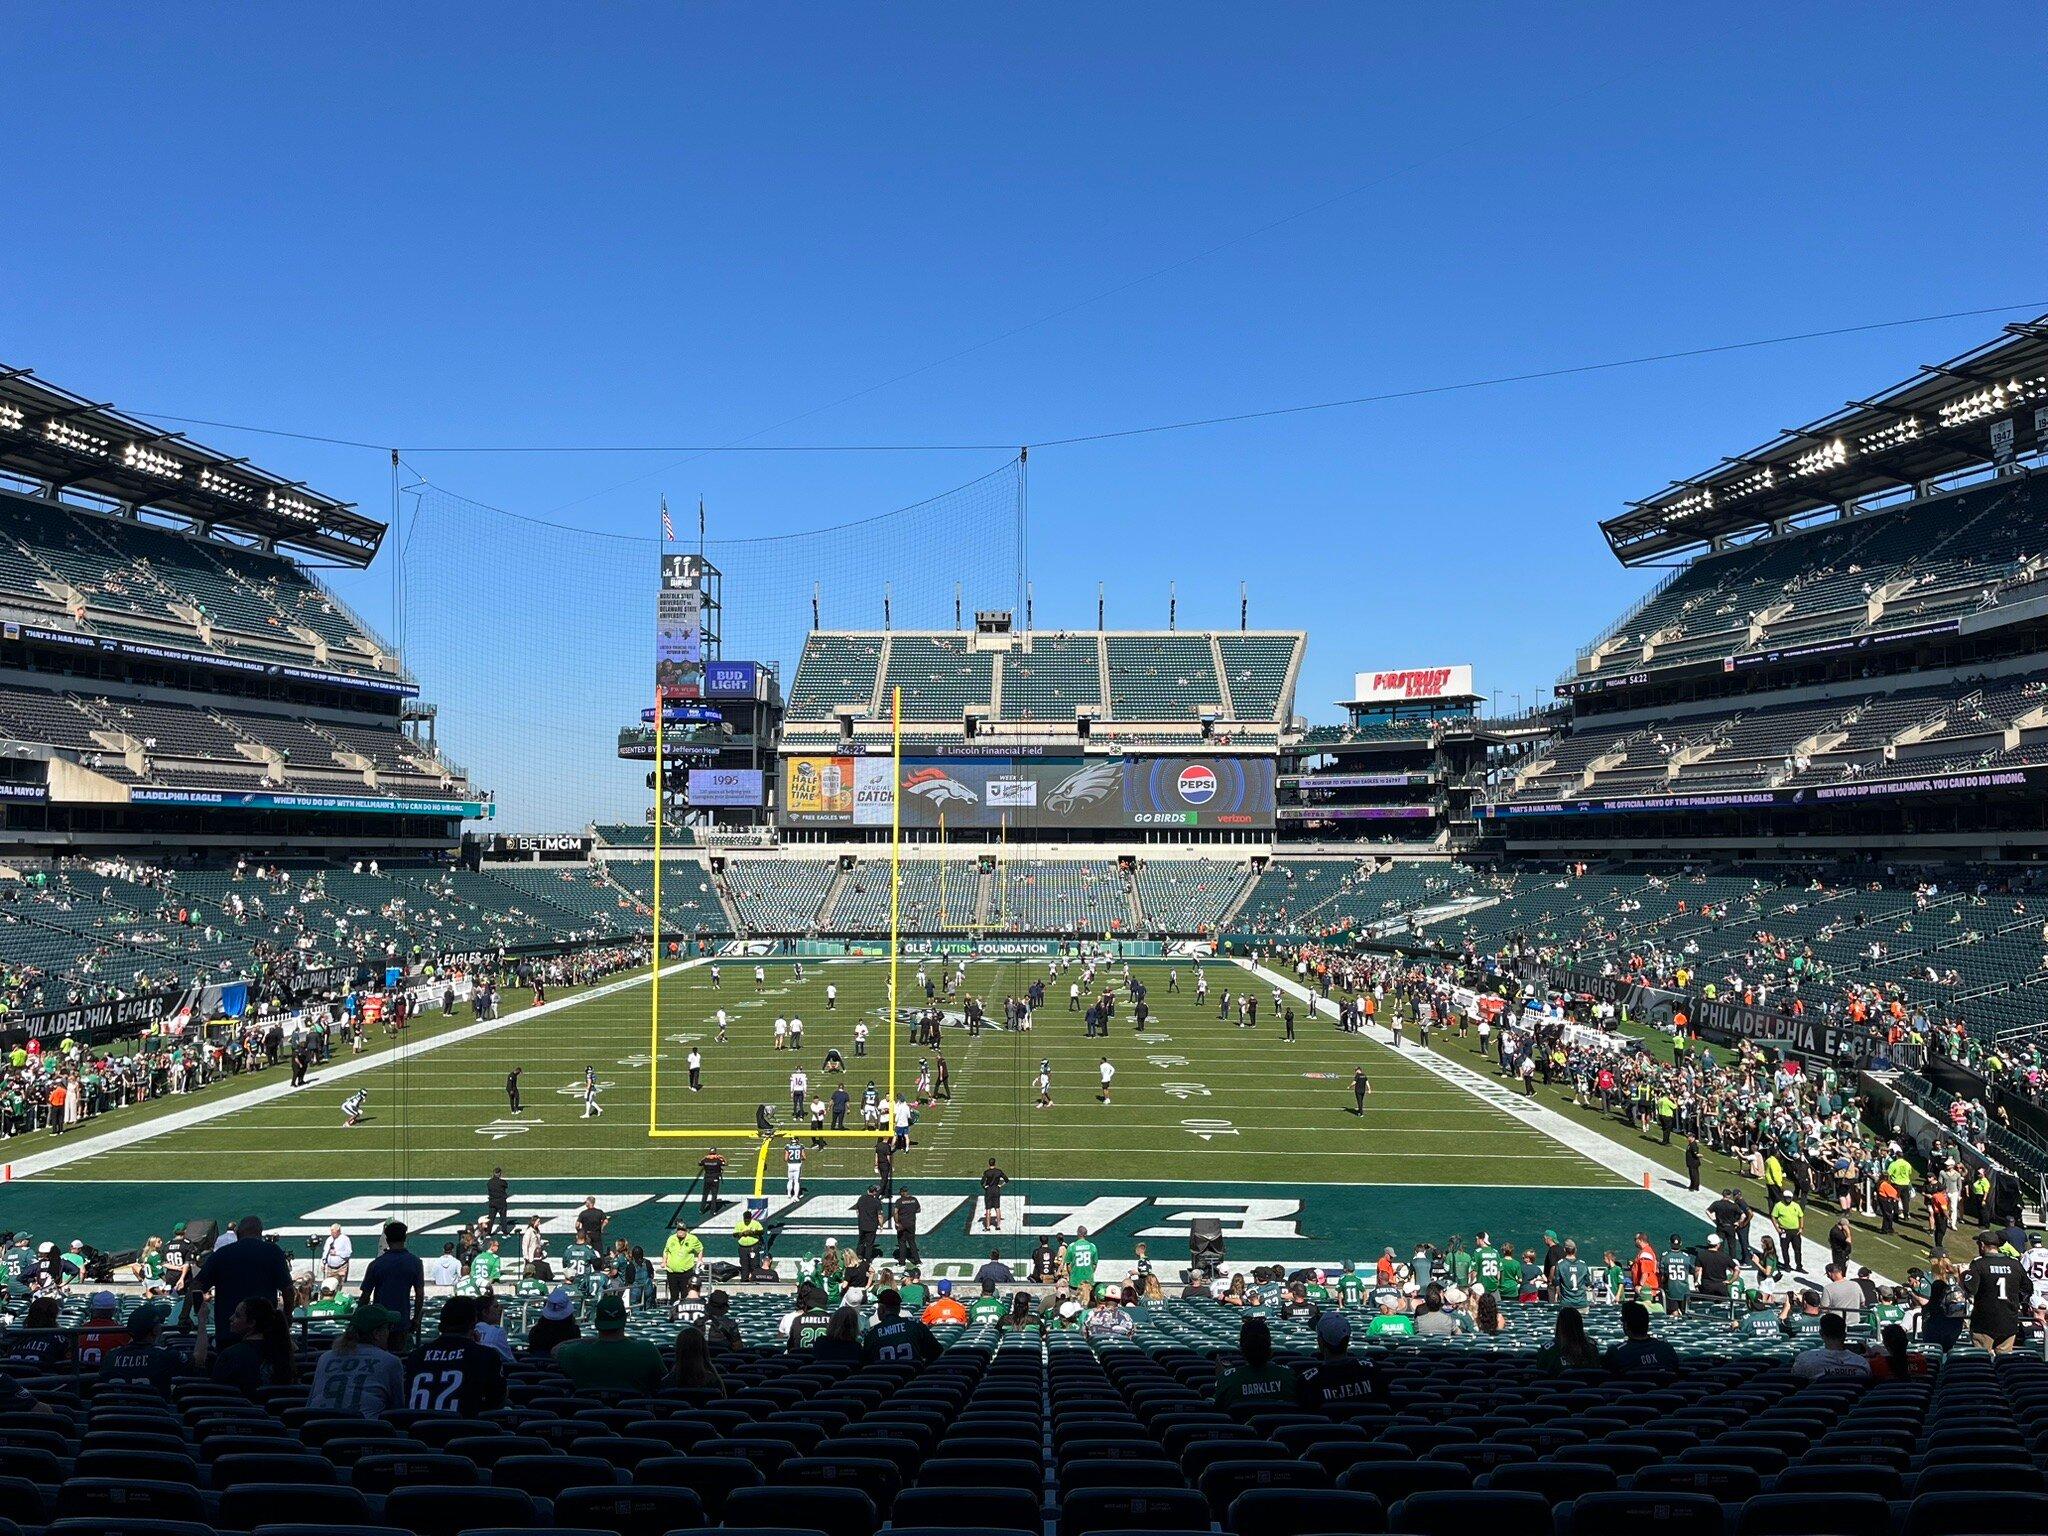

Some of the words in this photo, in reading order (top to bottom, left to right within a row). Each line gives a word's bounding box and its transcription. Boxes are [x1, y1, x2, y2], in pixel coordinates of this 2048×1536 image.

[122, 644, 136, 652] THE
[136, 646, 163, 657] OFFICIAL
[164, 650, 181, 659] MAYO
[182, 652, 190, 660] OF
[191, 654, 202, 662] THE
[203, 657, 243, 668] PHILADELPHIA
[716, 671, 743, 680] BUD
[1606, 678, 1627, 687] PREGAME
[1629, 674, 1648, 685] 54:22
[711, 680, 748, 690] LIGHT
[1405, 685, 1441, 697] BANK
[648, 745, 656, 753] BY
[672, 746, 702, 754] Jefferson
[838, 746, 865, 755] 54:22
[948, 746, 980, 755] Lincoln
[982, 746, 1021, 755] Financial
[1023, 746, 1043, 755] Field
[793, 775, 818, 784] HALF
[1180, 780, 1214, 789] PEPSI
[1817, 788, 1834, 799] WHEN
[1834, 787, 1847, 797] YOU
[1847, 786, 1857, 796] DO
[1857, 785, 1869, 796] DIP
[1869, 784, 1887, 795] WITH
[1933, 779, 1948, 791] YOU
[1949, 777, 1965, 788] CAN
[1966, 776, 1977, 787] DO
[1978, 775, 1990, 786] NO
[1991, 772, 2026, 785] WRONG.
[14, 786, 34, 797] MAYO
[35, 788, 45, 797] OF
[792, 784, 816, 792] HALF
[132, 790, 189, 802] HILADELPHIA
[190, 793, 222, 803] EAGLES
[792, 791, 814, 800] TIME
[858, 791, 894, 802] CATCH
[1616, 800, 1645, 809] OFFICIAL
[1646, 799, 1664, 808] MAYO
[1665, 798, 1674, 807] OF
[1675, 798, 1689, 806] THE
[1689, 795, 1742, 806] PHILADELPHIA
[1743, 793, 1774, 803] EAGLES
[273, 796, 295, 806] WHEN
[297, 797, 312, 806] YOU
[312, 798, 322, 806] DO
[324, 799, 335, 807] DIP
[337, 799, 354, 808] WITH
[410, 802, 422, 811] CAN
[423, 803, 431, 811] DO
[1509, 805, 1527, 813] THAT'S
[1135, 813, 1152, 823] GO
[1153, 813, 1186, 823] BIRDS
[1217, 814, 1252, 823] verizon
[978, 944, 1048, 954] FOUNDATION
[444, 951, 482, 967] EAGLES
[286, 972, 329, 992] ADELPHIA
[1580, 975, 1617, 1000] EAGLES
[25, 1006, 113, 1037] HILADELPHIA
[117, 997, 164, 1021] EAGLES
[1700, 1001, 1815, 1051] PHILADELPHIA
[788, 1149, 801, 1161] 28
[1075, 1251, 1092, 1267] 28
[475, 1265, 489, 1278] 26
[569, 1260, 585, 1275] 26
[1481, 1259, 1498, 1276] 26
[1668, 1264, 1686, 1281] 55
[1989, 1265, 2012, 1275] HURTS
[1570, 1273, 1579, 1291] 1
[1996, 1277, 2008, 1300] 1
[1345, 1287, 1357, 1303] 11
[801, 1315, 830, 1324] BARKLEY
[878, 1321, 906, 1337] R.WHITE
[114, 1354, 148, 1368] KELCE
[424, 1348, 464, 1362] KELCE
[1641, 1353, 1658, 1365] COX
[324, 1358, 379, 1373] COX
[322, 1374, 369, 1410] 91
[409, 1370, 464, 1410] 62
[1242, 1380, 1282, 1396] BARKLEY
